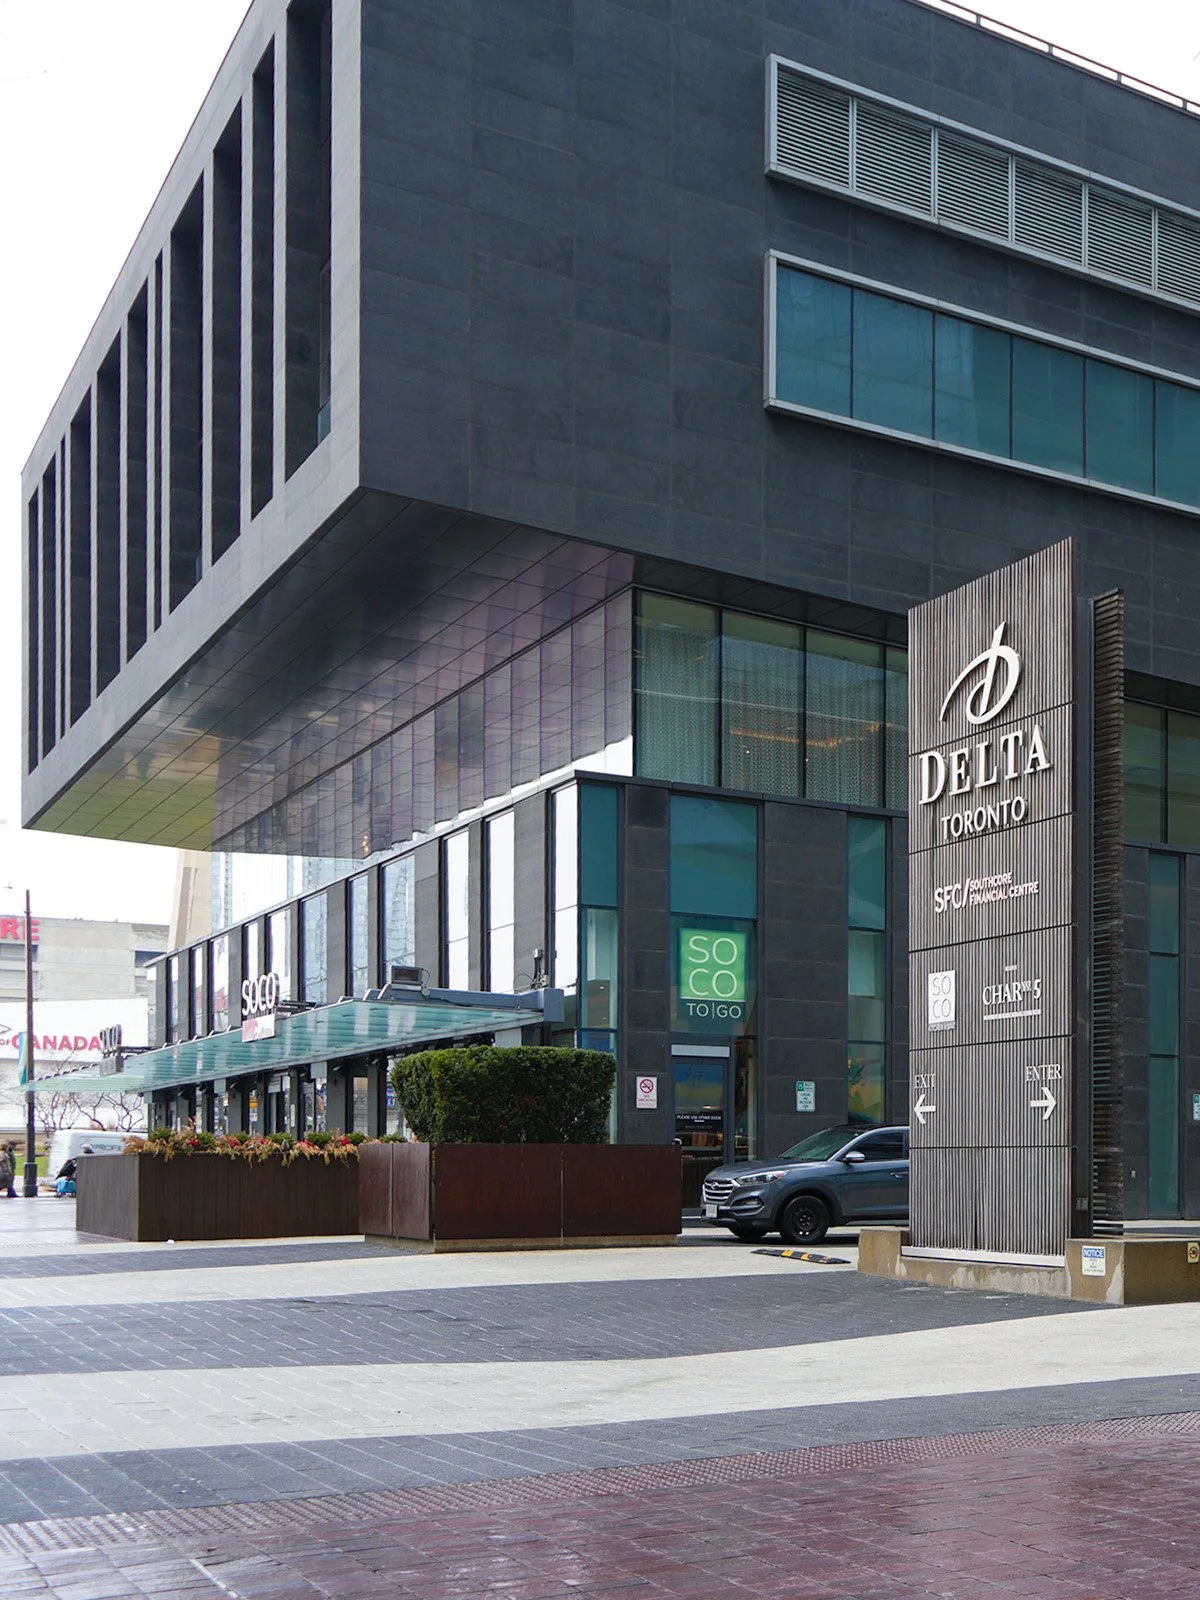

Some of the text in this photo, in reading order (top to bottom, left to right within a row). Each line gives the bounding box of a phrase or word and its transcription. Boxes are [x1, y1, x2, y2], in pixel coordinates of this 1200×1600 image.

[919, 724, 1052, 805] DELTA
[941, 796, 1026, 840] TORONTO
[969, 871, 1013, 891] SOUTHCORE
[969, 881, 1040, 906] FINANCIAL CENTRE
[241, 972, 276, 1016] SOCO
[1033, 978, 1042, 999] 5
[914, 1073, 936, 1089] EXIT
[1025, 1064, 1062, 1082] ENTER
[1083, 1249, 1104, 1258] NOTICE
